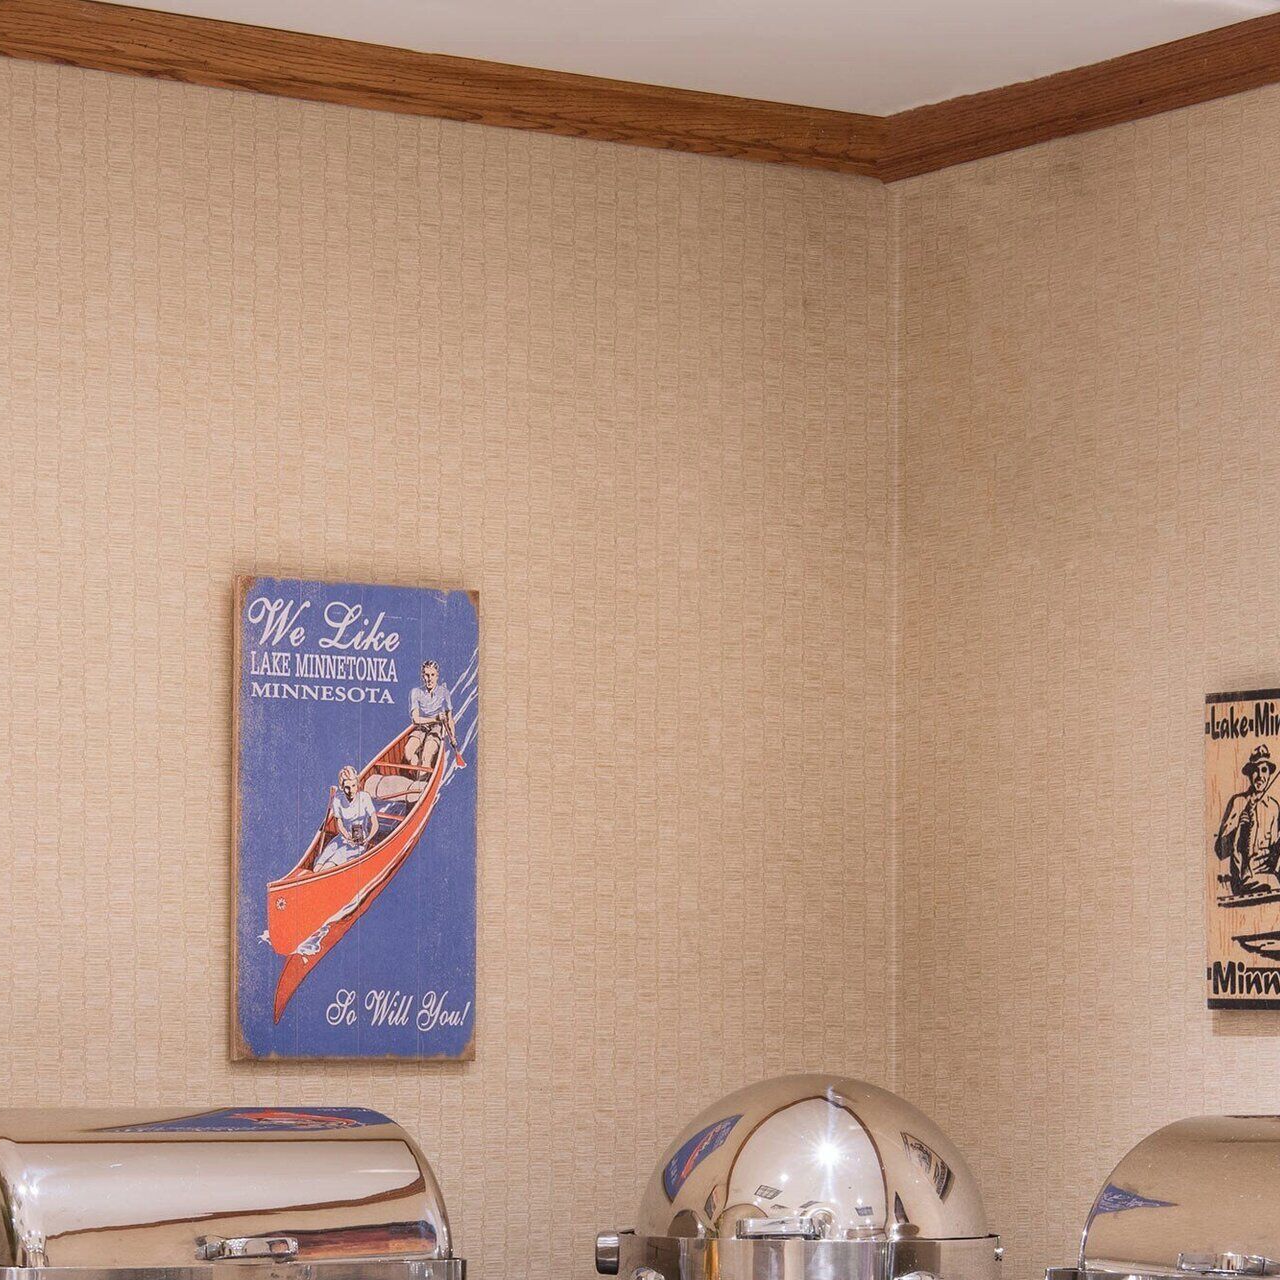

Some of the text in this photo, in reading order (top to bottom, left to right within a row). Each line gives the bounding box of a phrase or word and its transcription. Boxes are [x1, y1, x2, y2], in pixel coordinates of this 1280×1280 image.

[248, 597, 400, 652] We Like
[250, 651, 398, 683] LAKE MINNETONKA
[250, 682, 395, 705] MINNESOTA
[1210, 706, 1249, 740] Lake
[326, 988, 470, 1031] So Will You!
